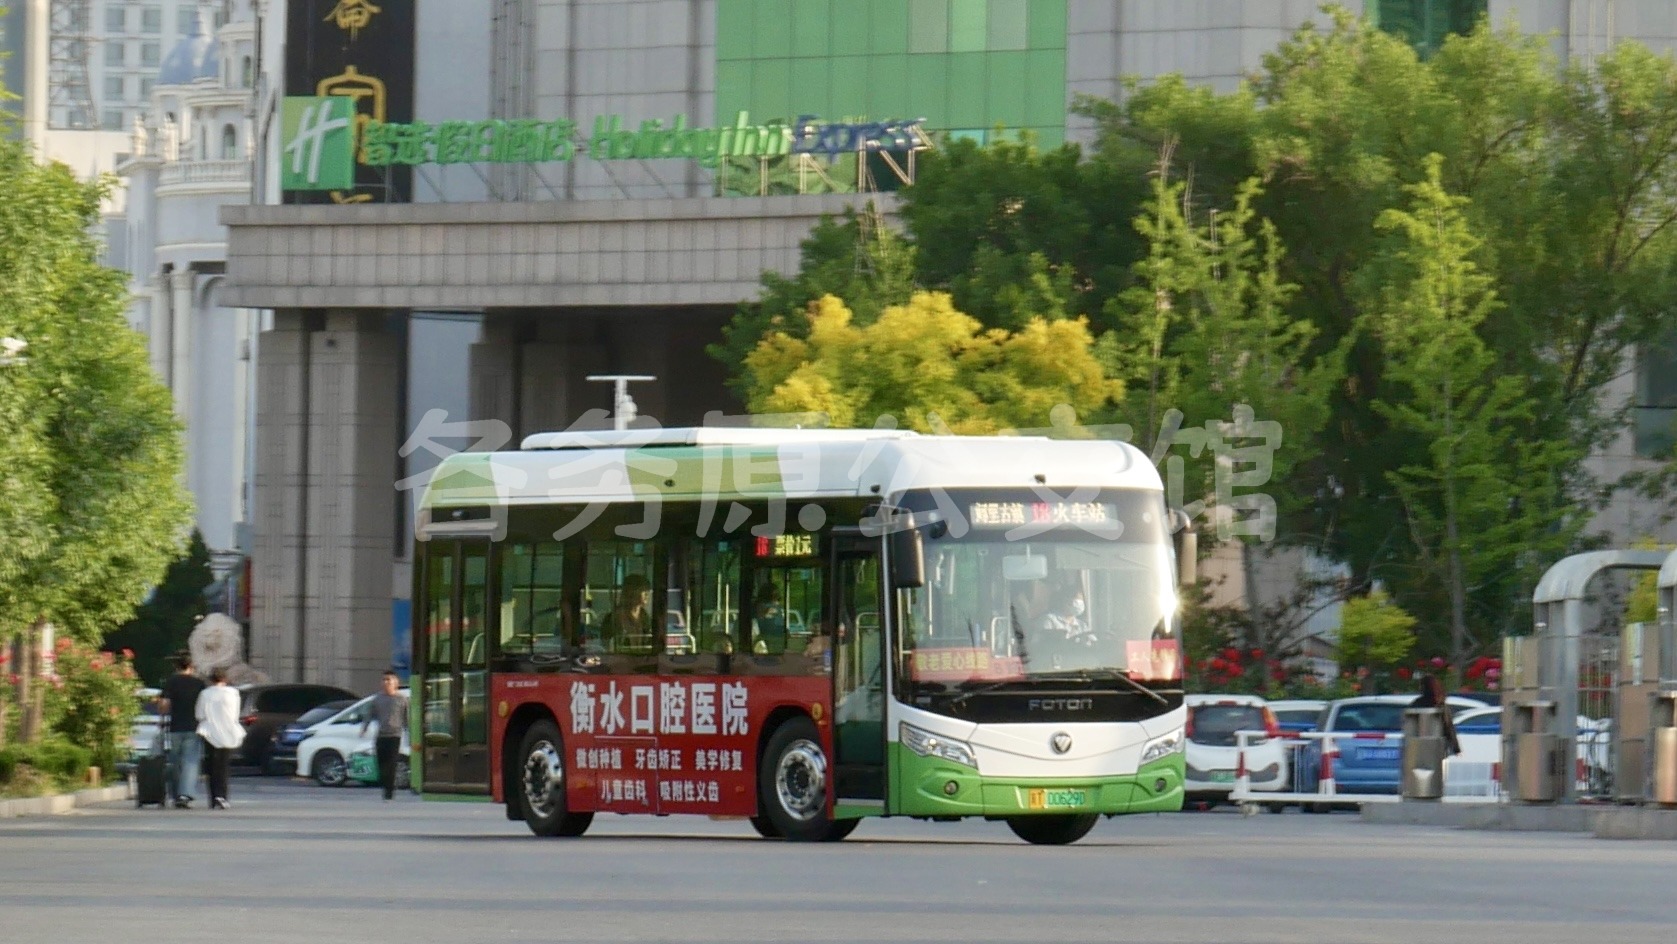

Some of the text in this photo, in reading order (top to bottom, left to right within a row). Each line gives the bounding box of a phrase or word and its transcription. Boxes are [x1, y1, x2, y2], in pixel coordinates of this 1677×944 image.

[1053, 502, 1106, 524] 火车站
[569, 680, 749, 736] 衡水口腔医院
[1028, 698, 1093, 711] FOTON
[635, 748, 682, 770] 牙齿矫正
[695, 749, 743, 772] 美学修复
[601, 779, 720, 803] 儿童齿科 吸附性义齿
